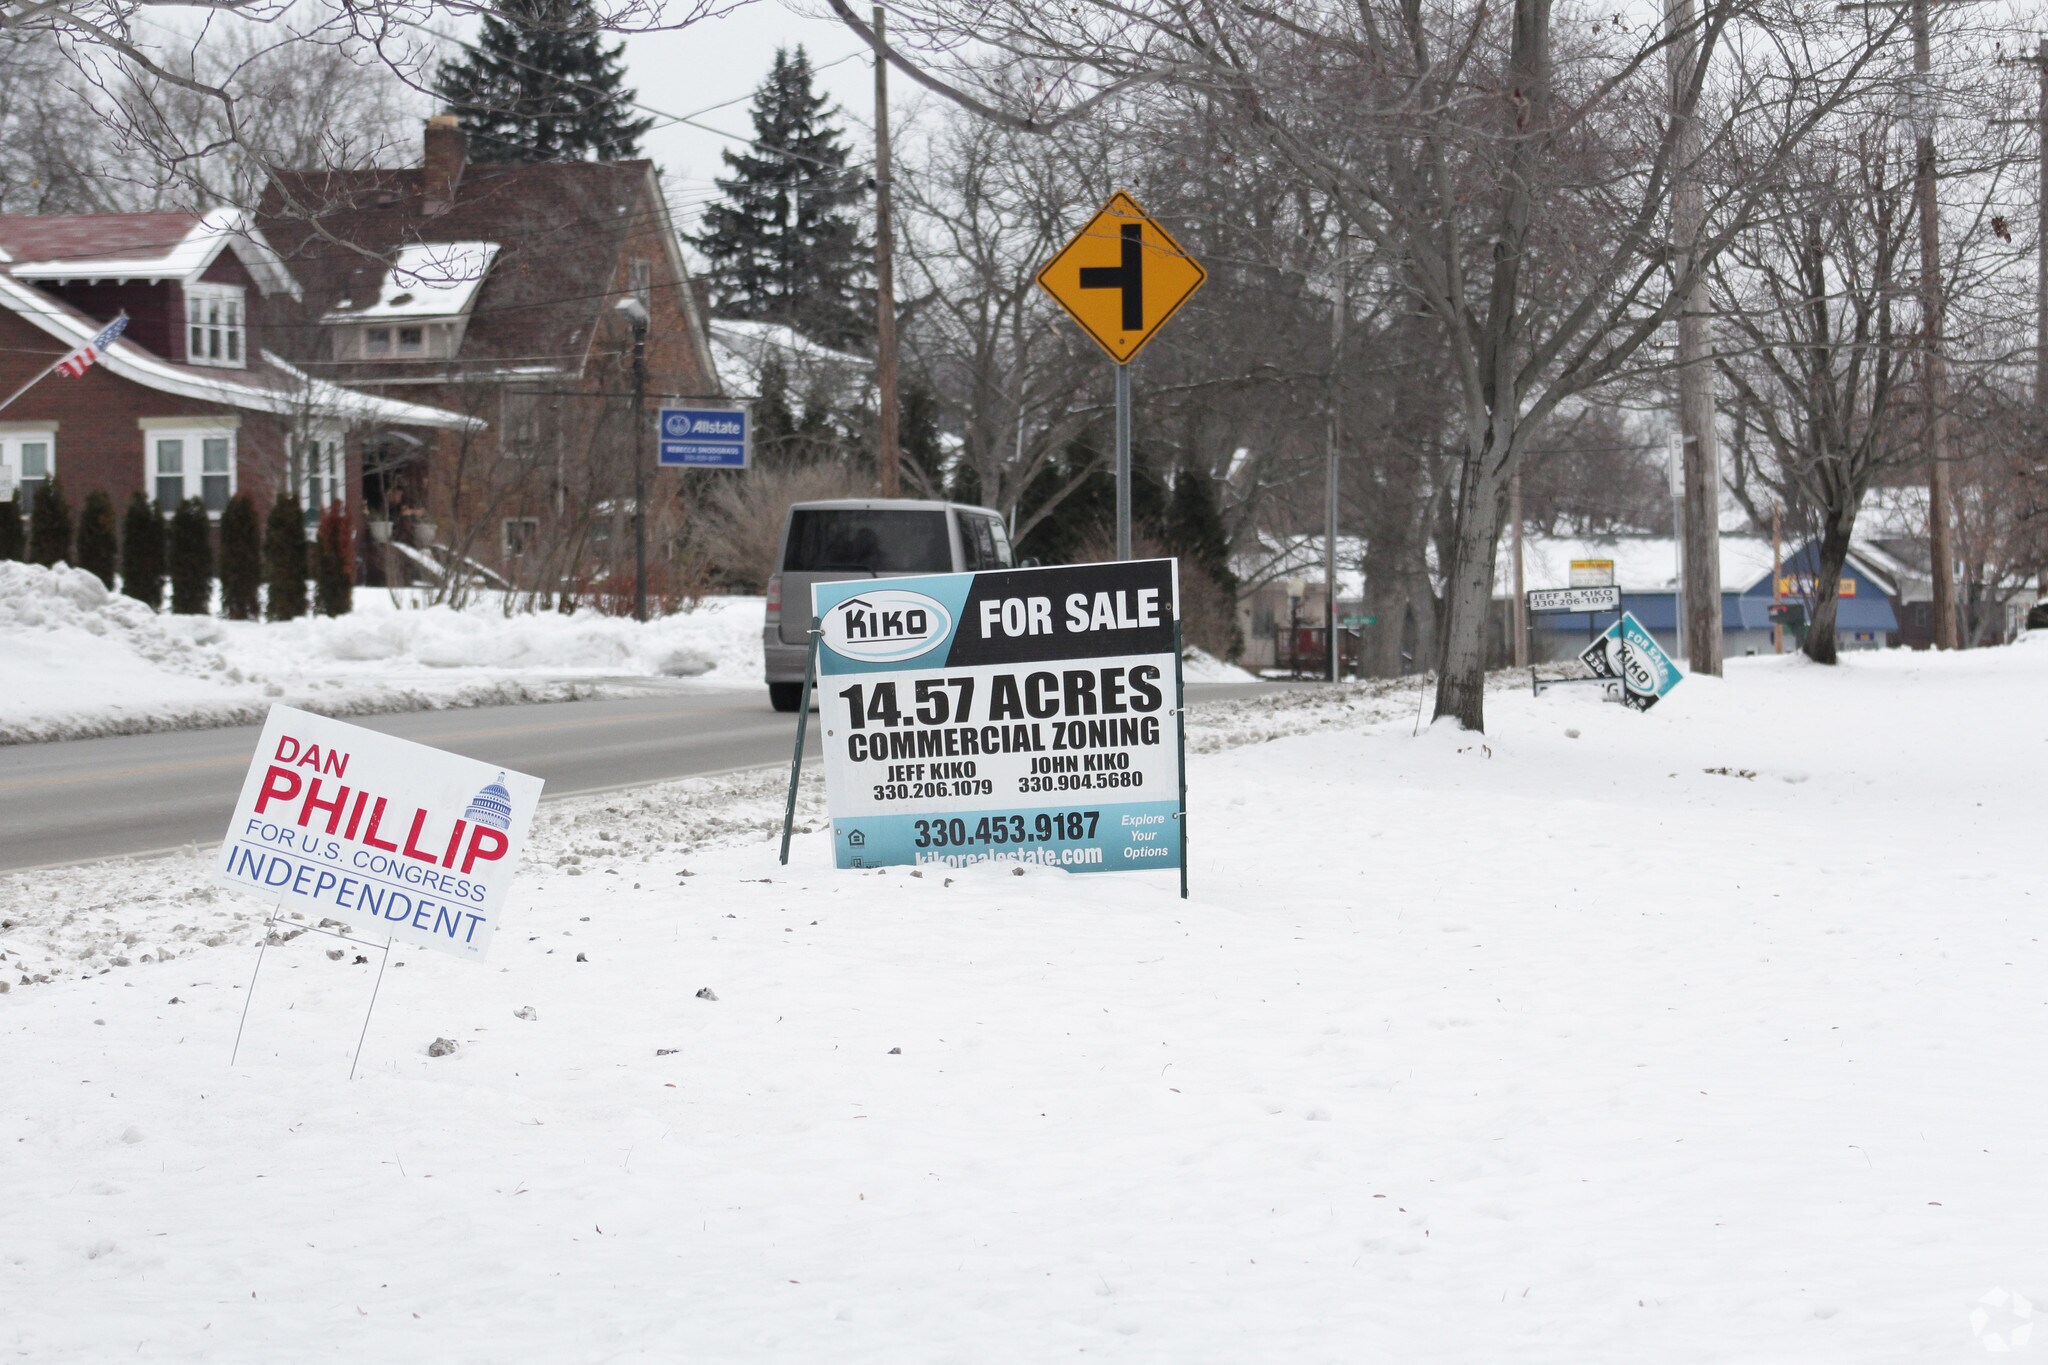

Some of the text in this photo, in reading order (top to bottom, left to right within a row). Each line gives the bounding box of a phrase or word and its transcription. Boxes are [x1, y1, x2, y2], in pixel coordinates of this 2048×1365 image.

[692, 420, 740, 434] Allstate
[1532, 589, 1613, 601] JEFF R. KIKO
[1533, 596, 1614, 608] 330-206-1079
[845, 609, 927, 639] KIKO
[979, 588, 1161, 639] FOR SALE
[1615, 646, 1649, 684] KIKO
[1627, 630, 1669, 679] FOR SALE
[839, 664, 1163, 730] 14.57 ACRES
[847, 715, 1161, 762] COMMERCIAL ZONING
[274, 734, 350, 779] DAN
[887, 760, 977, 783] JEFF KIKO
[1030, 751, 1130, 775] JOHN KIKO
[873, 779, 993, 801] 330.206.1079
[1018, 770, 1144, 794] 330.904.5680
[253, 764, 509, 875] PHILLIP
[914, 811, 1101, 848] 330.453.9187
[1120, 812, 1165, 827] Explore
[1130, 829, 1158, 843] Your
[245, 818, 487, 903] FOR U.S. CONGRESS
[1123, 845, 1169, 860] Options
[226, 845, 487, 943] INDEPENDENT
